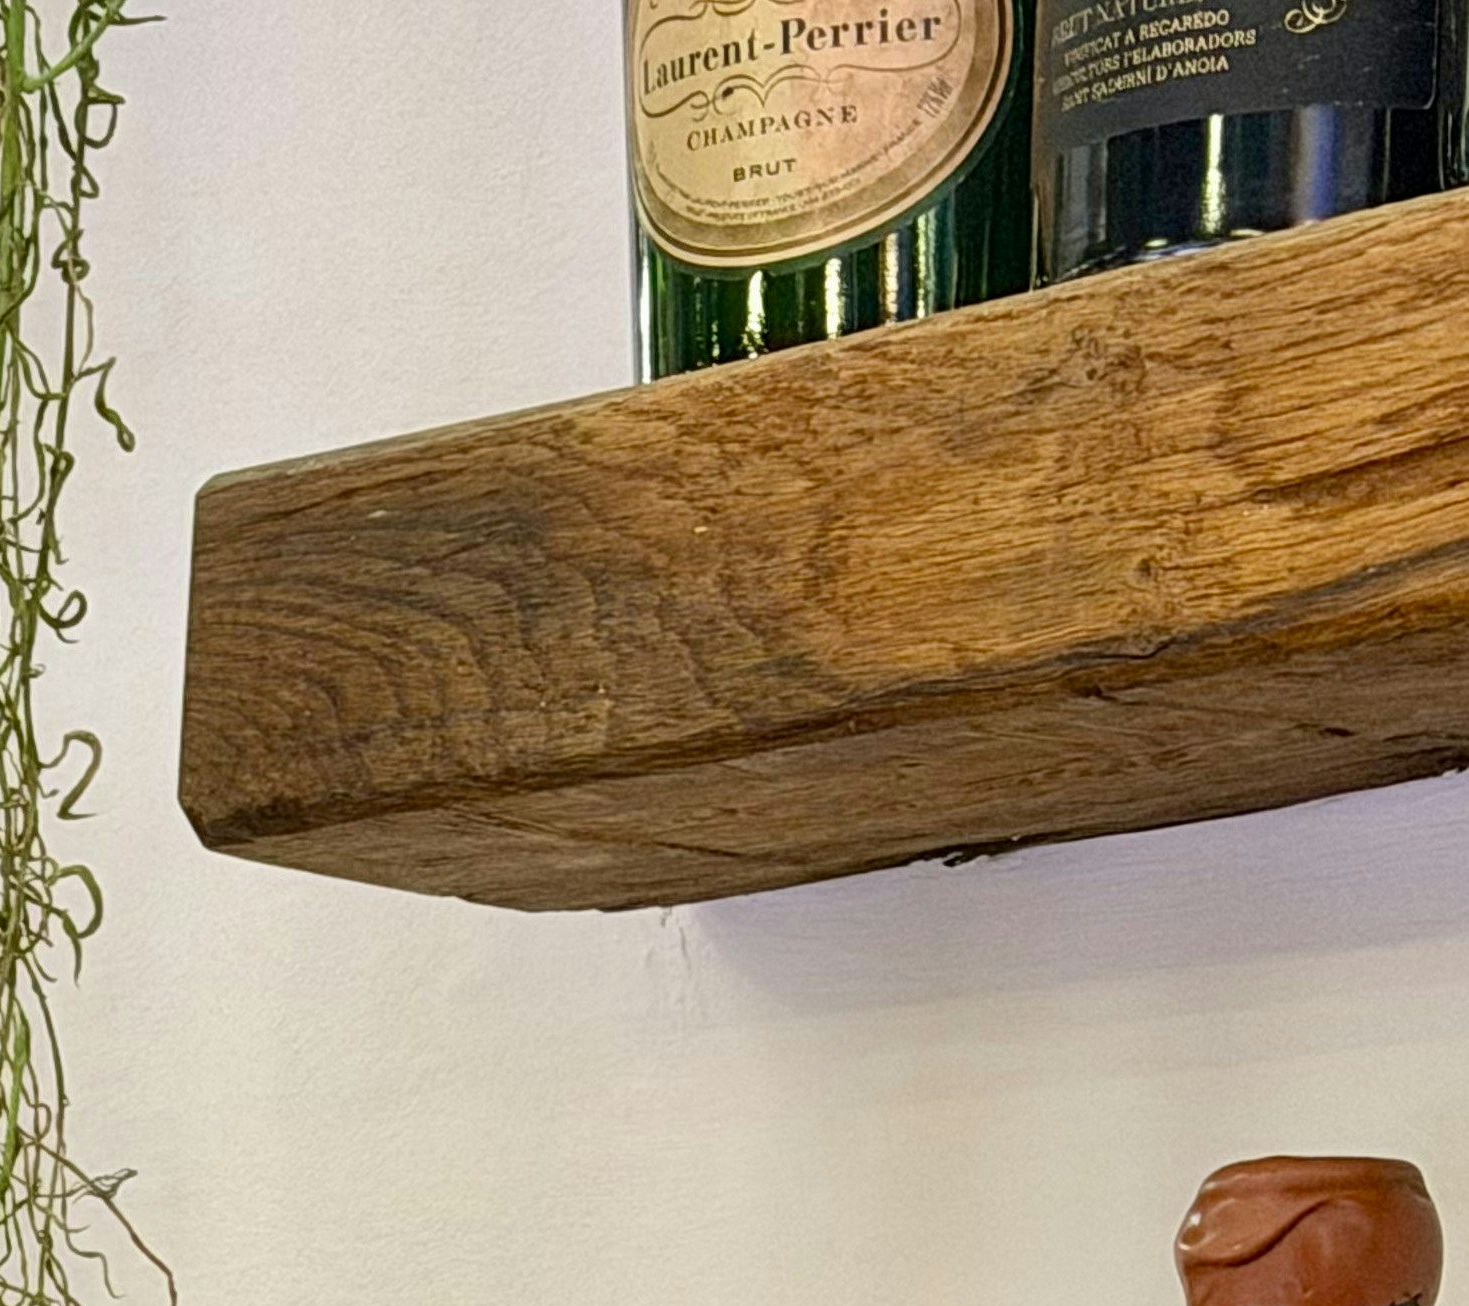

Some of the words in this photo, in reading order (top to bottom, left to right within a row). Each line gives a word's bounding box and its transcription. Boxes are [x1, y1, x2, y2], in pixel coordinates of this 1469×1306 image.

[1138, 9, 1230, 41] RECAREDO
[642, 8, 942, 96] Laurent-Perrier
[686, 105, 858, 151] CHAMPAGNE
[732, 157, 798, 183] BRUT
